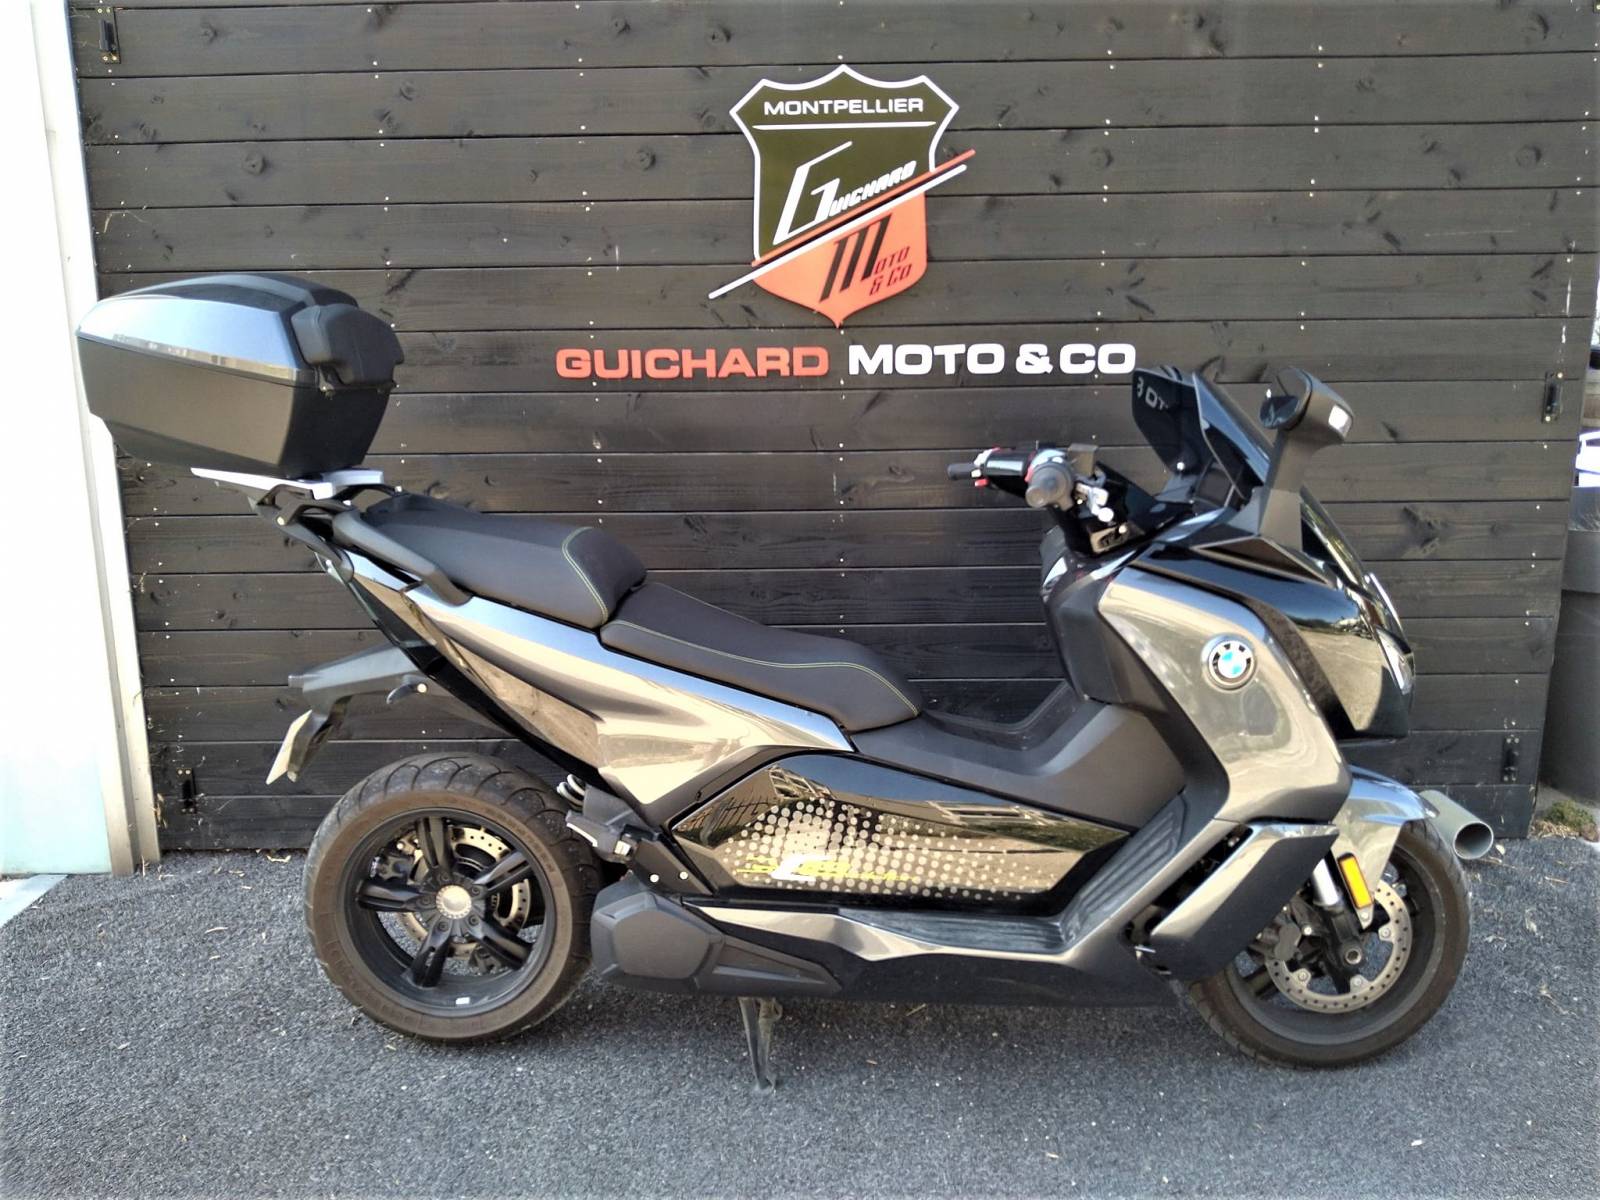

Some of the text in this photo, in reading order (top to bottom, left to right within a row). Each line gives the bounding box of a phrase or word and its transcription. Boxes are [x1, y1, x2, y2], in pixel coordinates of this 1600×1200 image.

[764, 98, 923, 116] MONTPELLIER
[556, 346, 829, 379] GUICHARD
[848, 342, 1005, 375] MOTO
